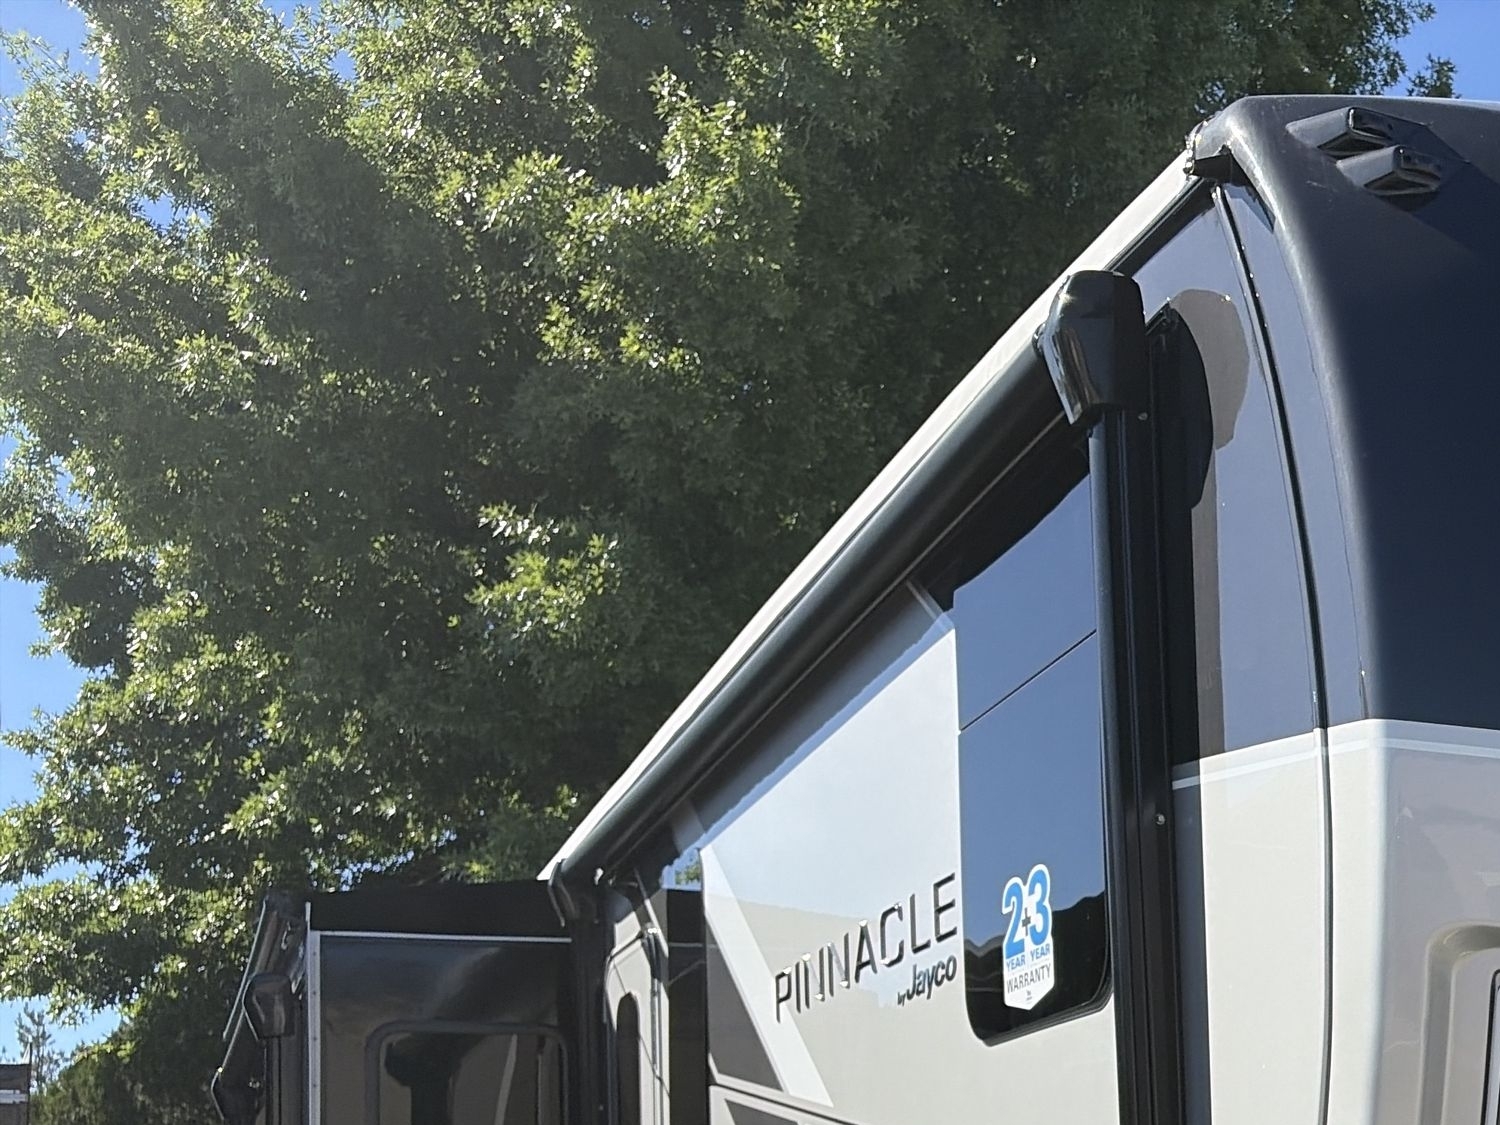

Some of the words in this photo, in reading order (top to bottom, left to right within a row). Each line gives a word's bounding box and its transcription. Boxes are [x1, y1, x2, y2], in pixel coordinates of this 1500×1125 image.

[775, 872, 957, 1023] PINNACLE
[1006, 954, 1026, 972] YEAR
[1030, 943, 1051, 960] YEAR
[907, 955, 957, 1000] Jayco
[1006, 963, 1051, 994] WARRANTY
